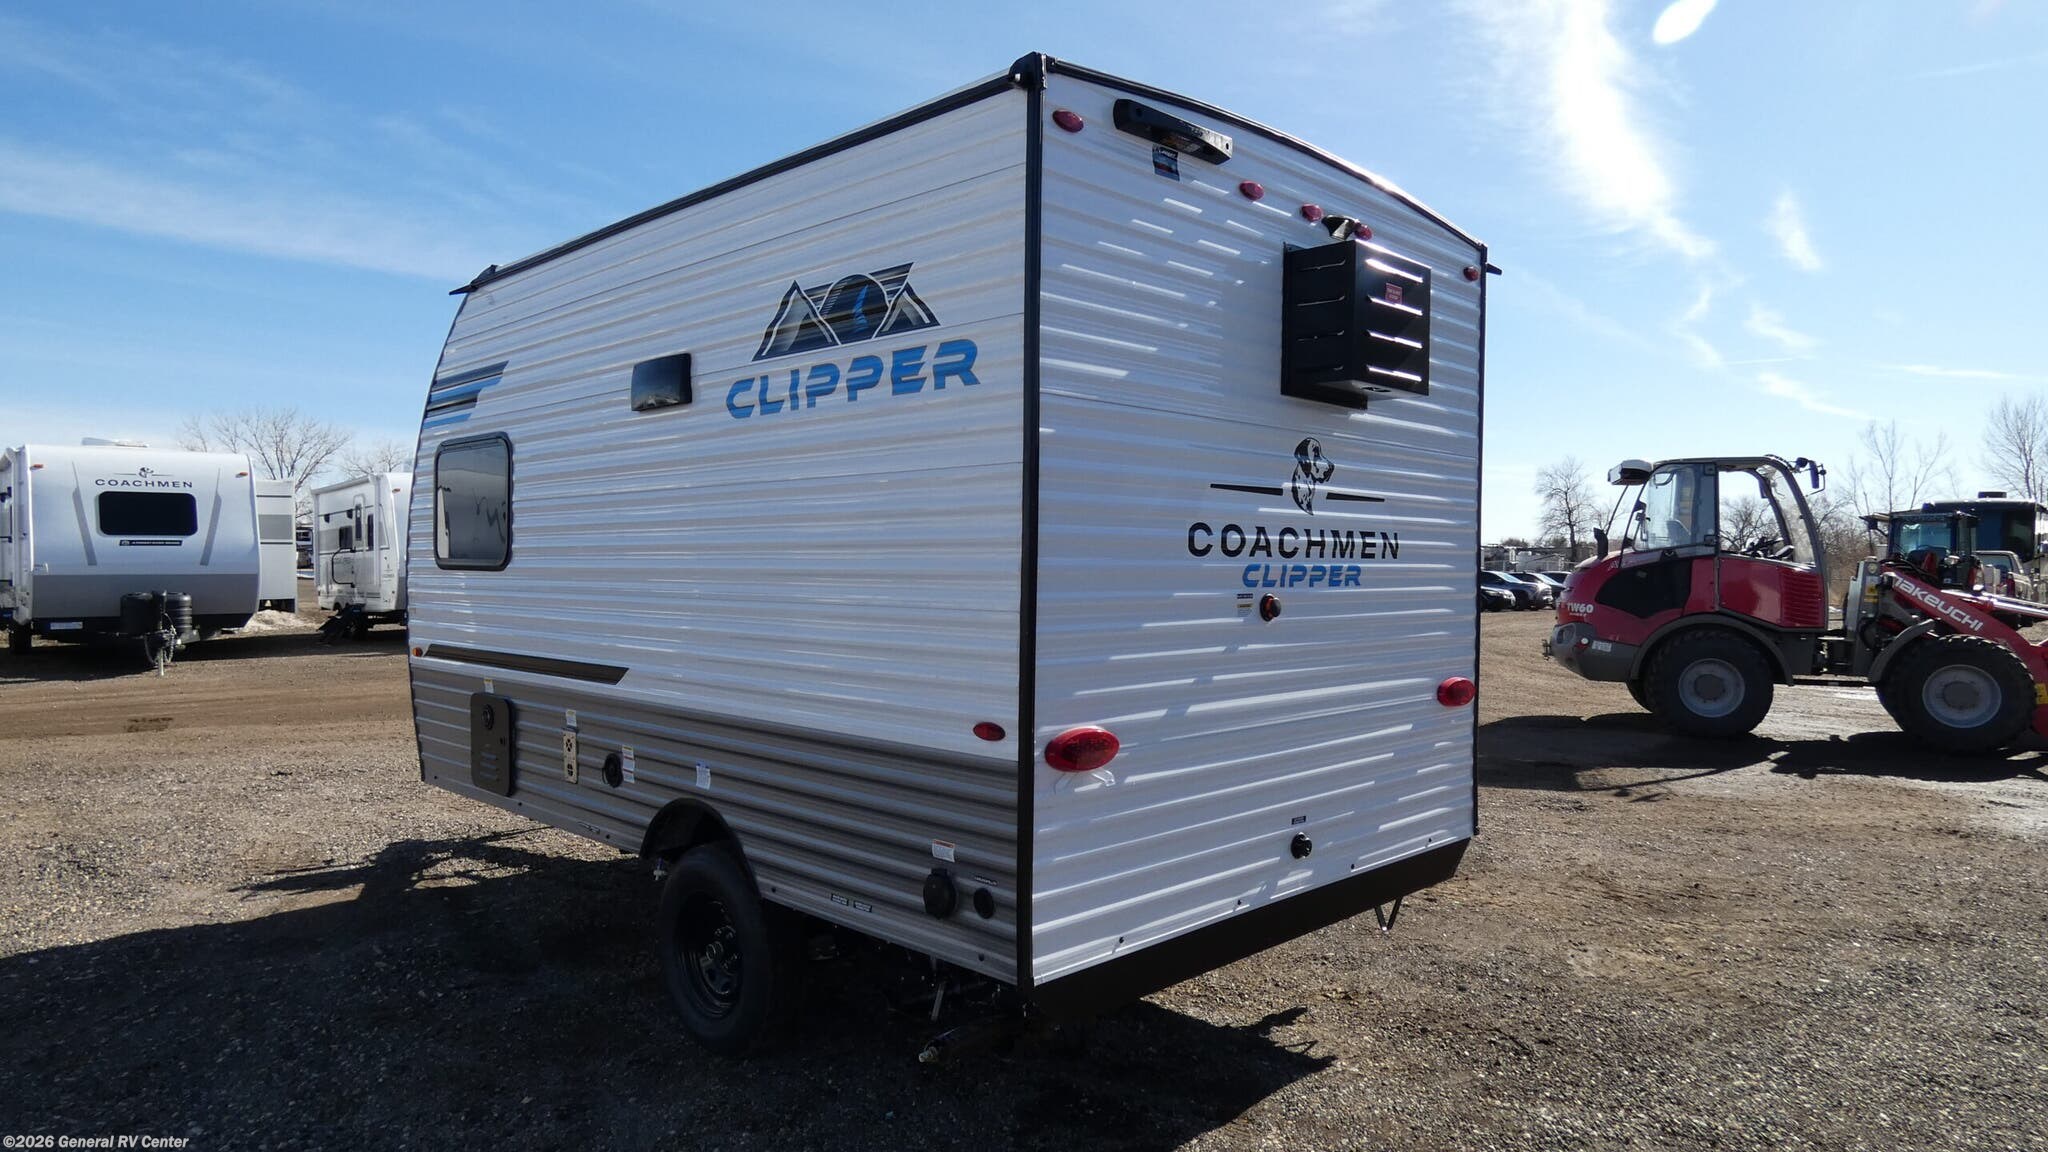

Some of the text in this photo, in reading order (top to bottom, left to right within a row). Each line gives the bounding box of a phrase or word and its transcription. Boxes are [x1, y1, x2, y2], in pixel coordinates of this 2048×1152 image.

[726, 338, 981, 419] CLIPPER
[95, 479, 192, 488] COACHMEN
[1188, 522, 1399, 559] COACHMEN
[1241, 563, 1362, 588] CLIPPER
[1567, 602, 1594, 613] TW60
